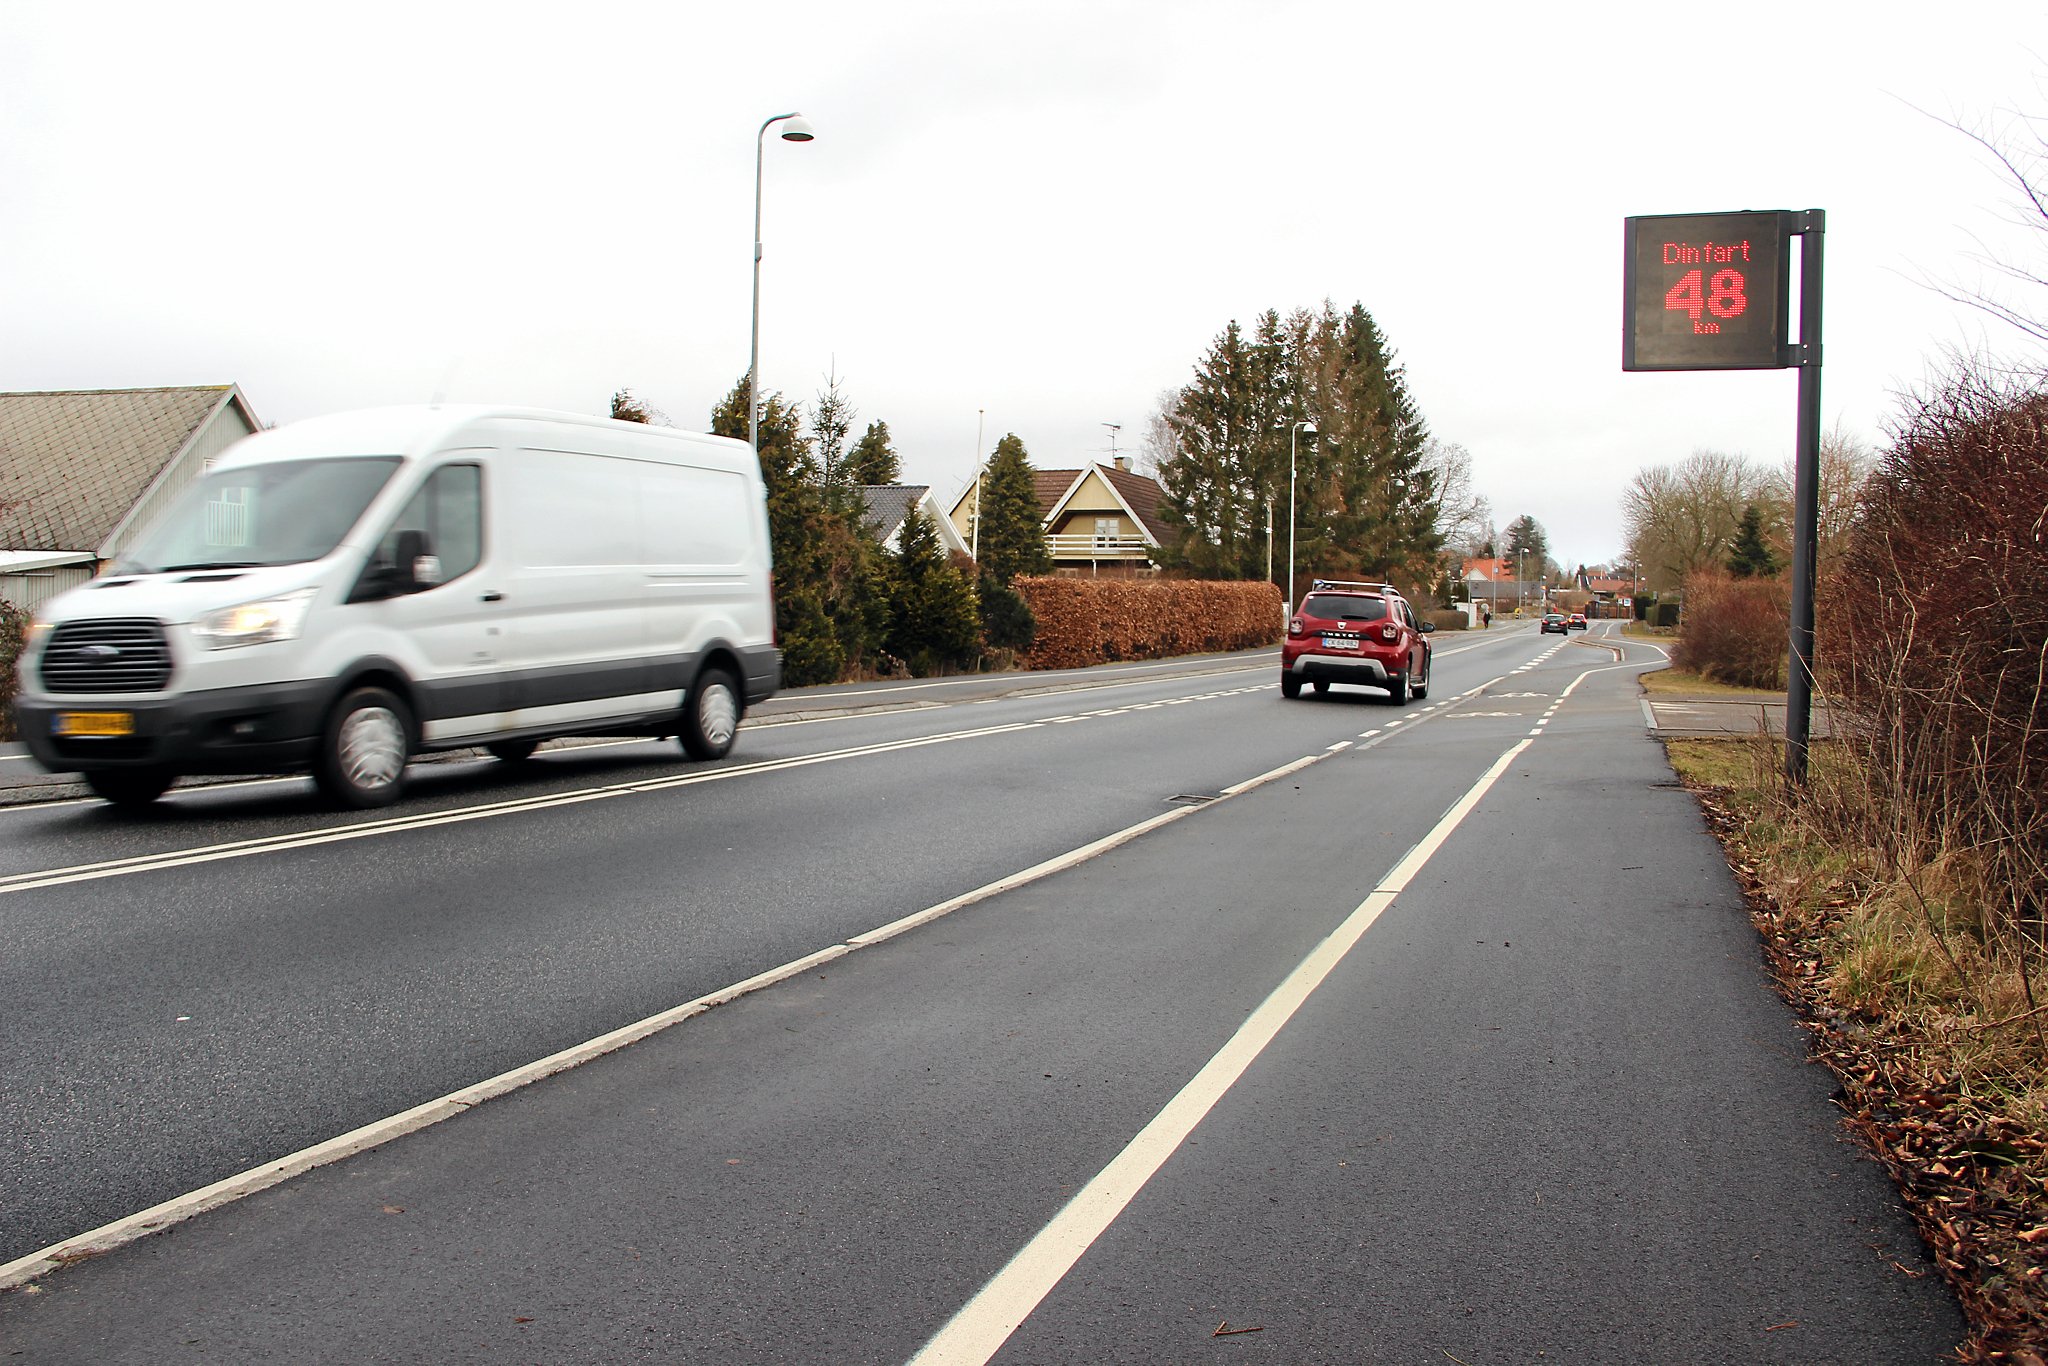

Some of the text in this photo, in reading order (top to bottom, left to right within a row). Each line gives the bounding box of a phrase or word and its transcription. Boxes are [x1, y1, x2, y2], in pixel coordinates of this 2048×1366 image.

[1663, 240, 1751, 264] Din fart
[1664, 268, 1747, 319] 48
[1693, 320, 1721, 334] km
